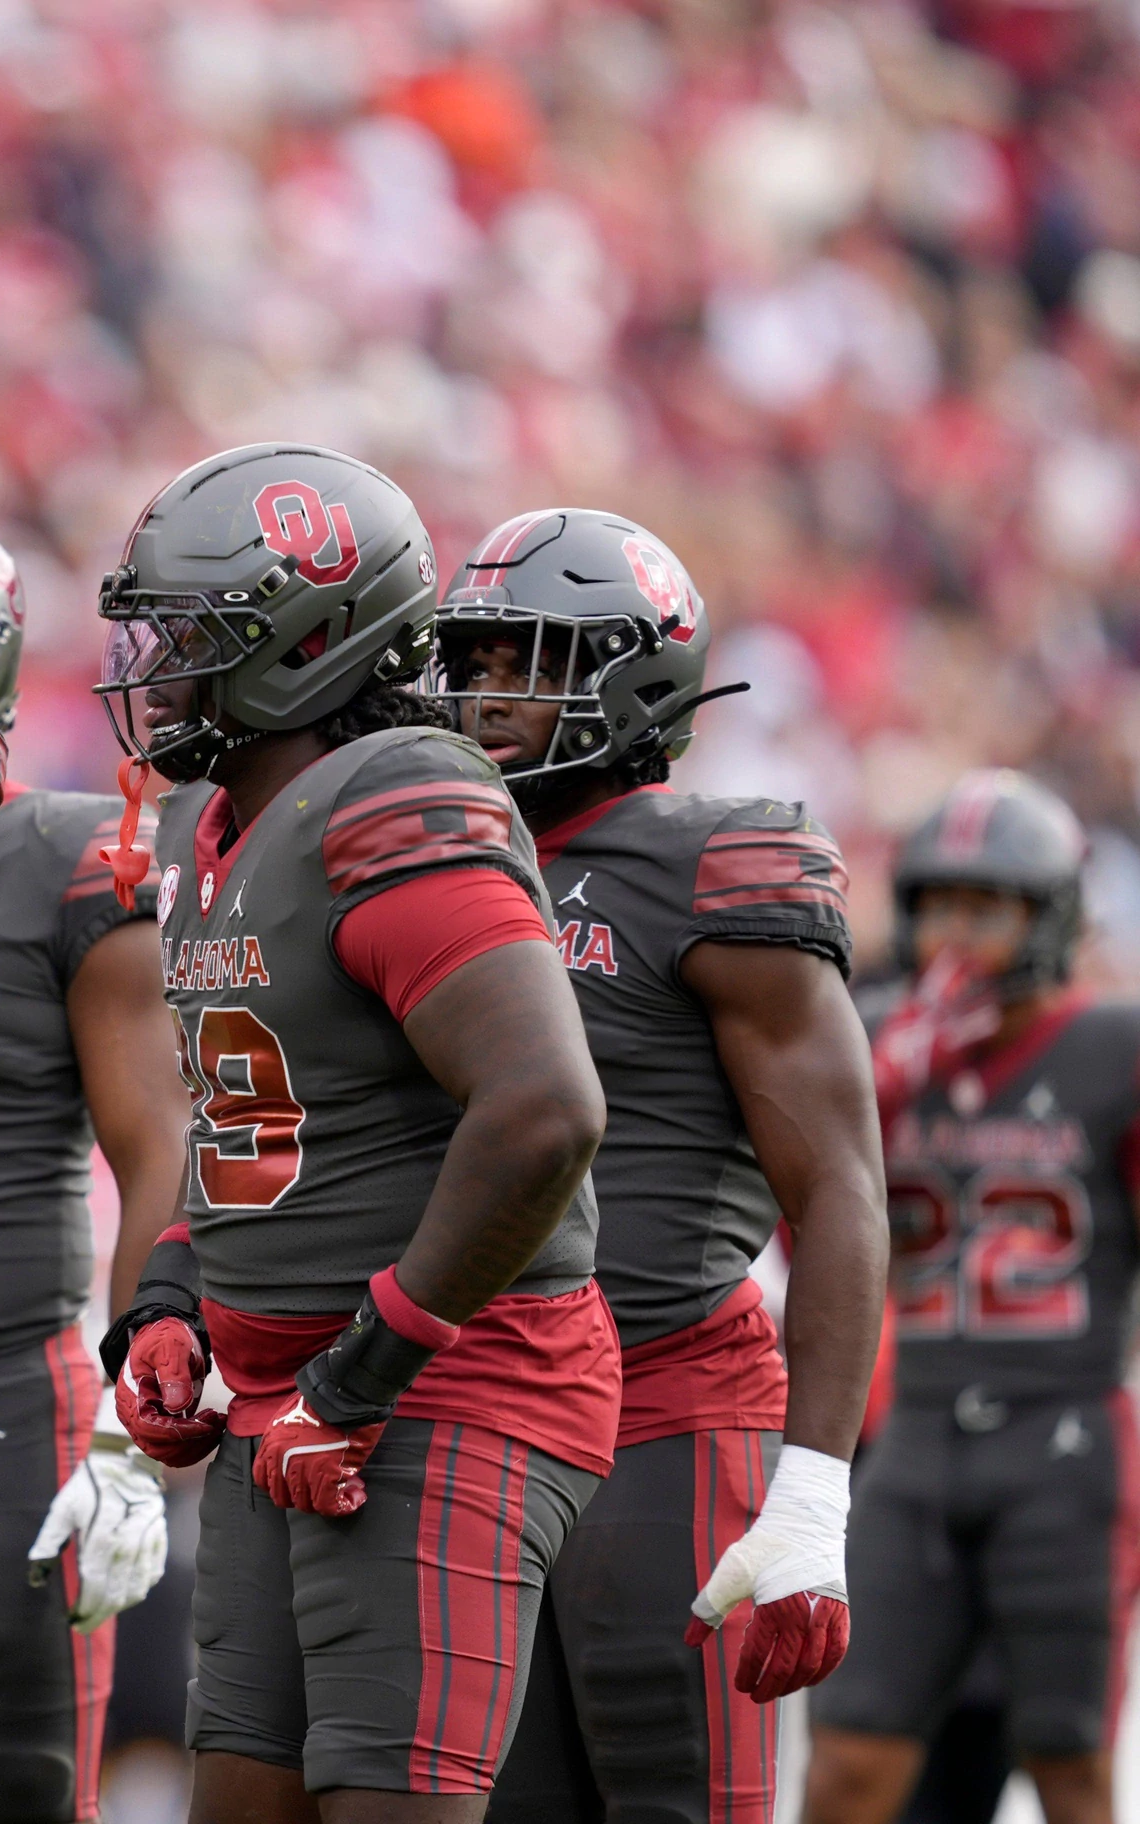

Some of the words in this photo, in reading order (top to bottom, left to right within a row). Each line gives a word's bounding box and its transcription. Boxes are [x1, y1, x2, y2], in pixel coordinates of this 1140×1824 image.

[253, 480, 361, 588] OU
[621, 537, 696, 645] OU
[162, 936, 270, 991] LAHOMA
[168, 1004, 306, 1209] 9
